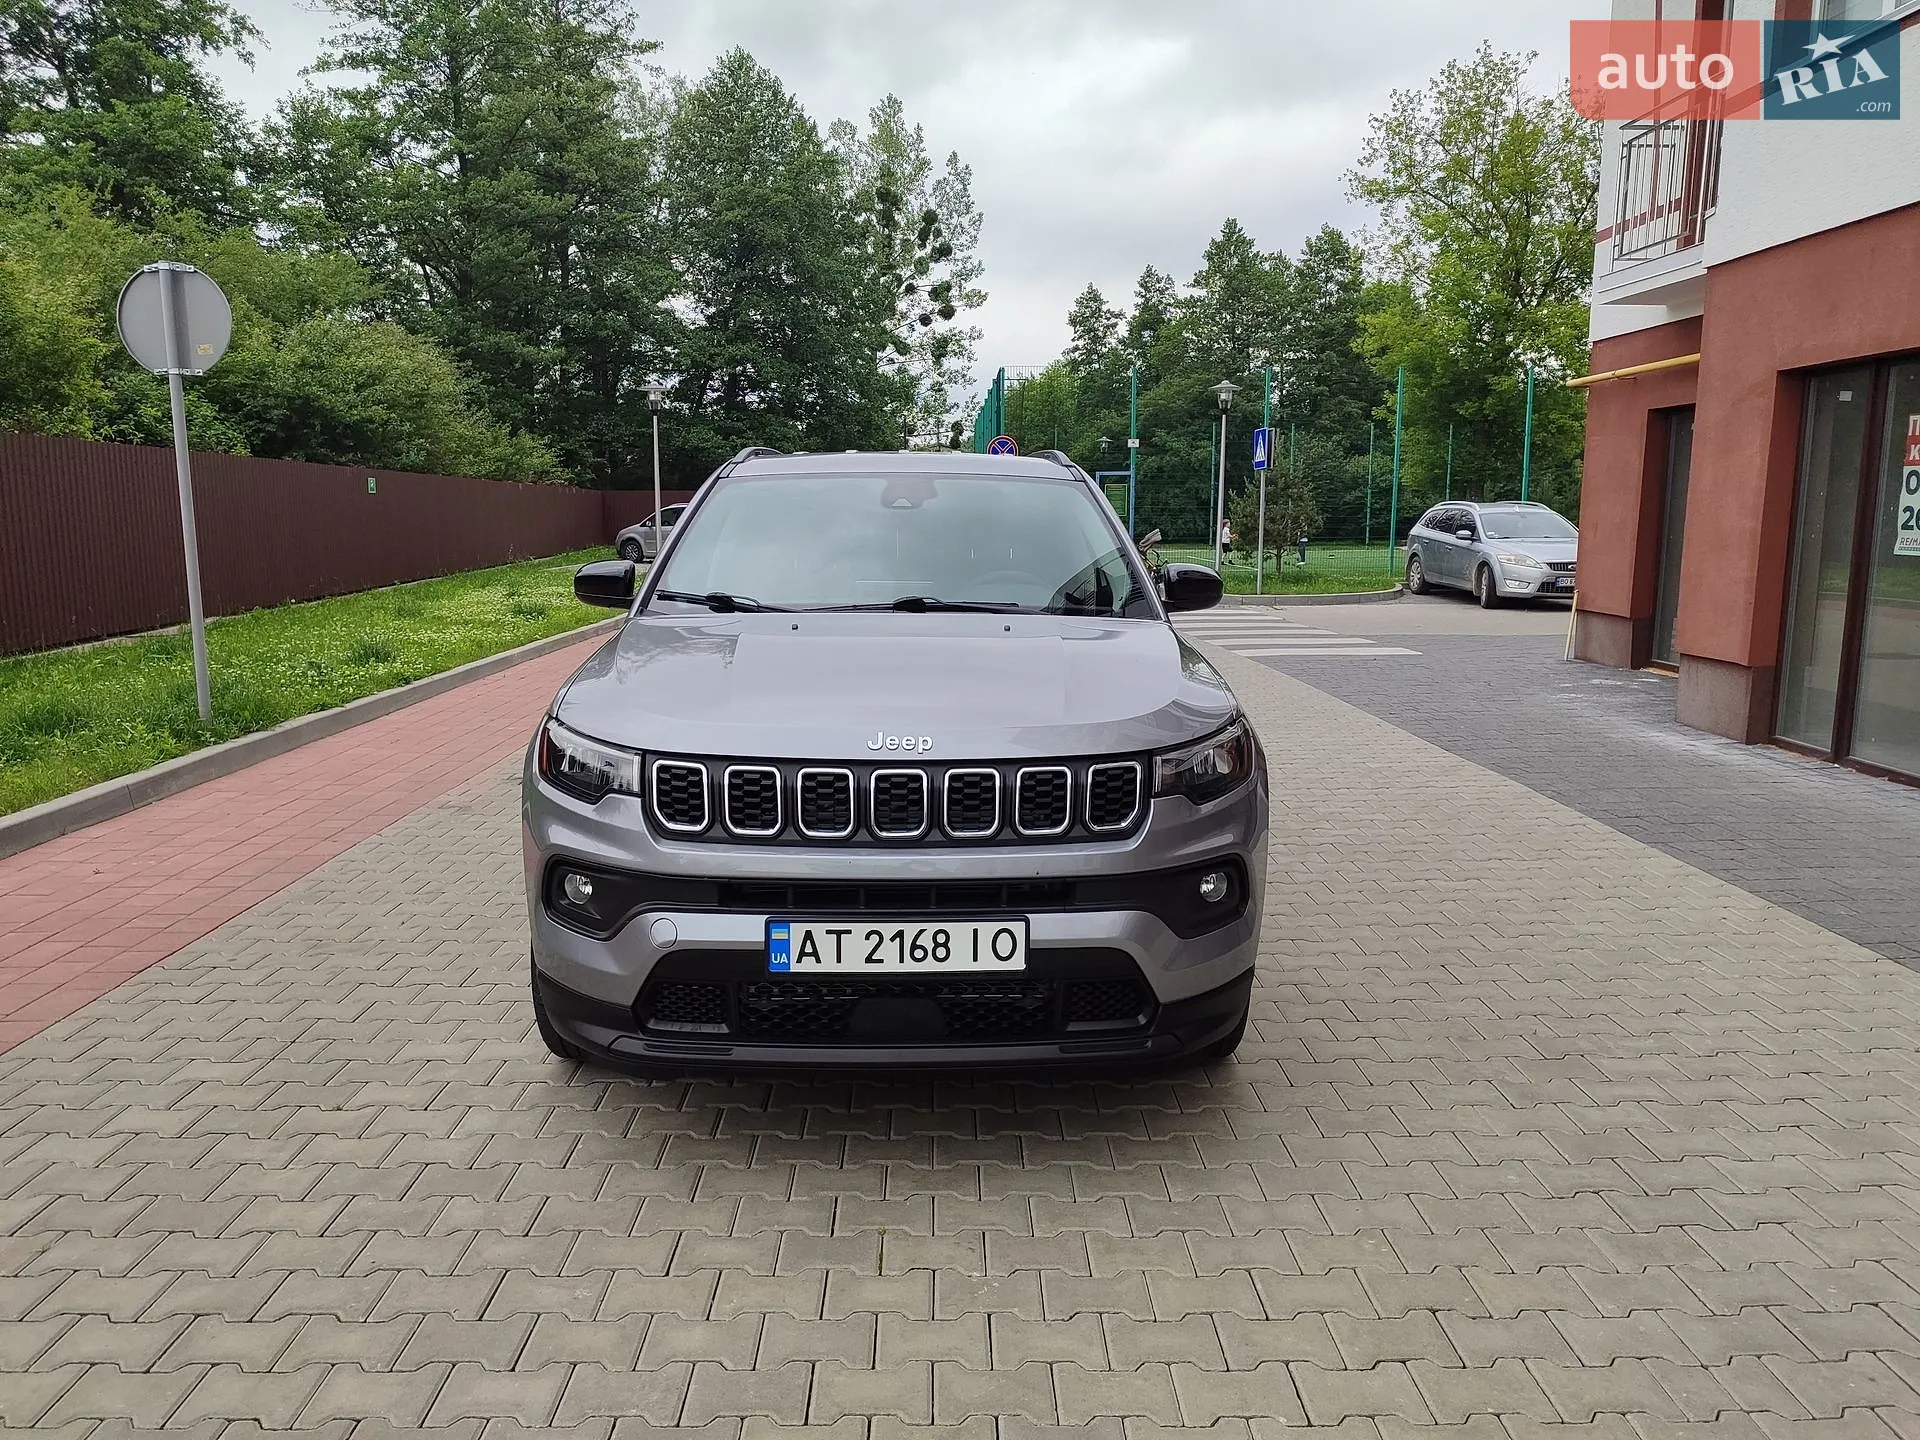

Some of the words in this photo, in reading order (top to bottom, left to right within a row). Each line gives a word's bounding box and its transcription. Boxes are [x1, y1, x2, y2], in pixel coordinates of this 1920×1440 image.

[867, 731, 933, 754] Jeep
[796, 929, 853, 964] AT
[864, 928, 951, 964] 2168
[771, 953, 789, 964] UA
